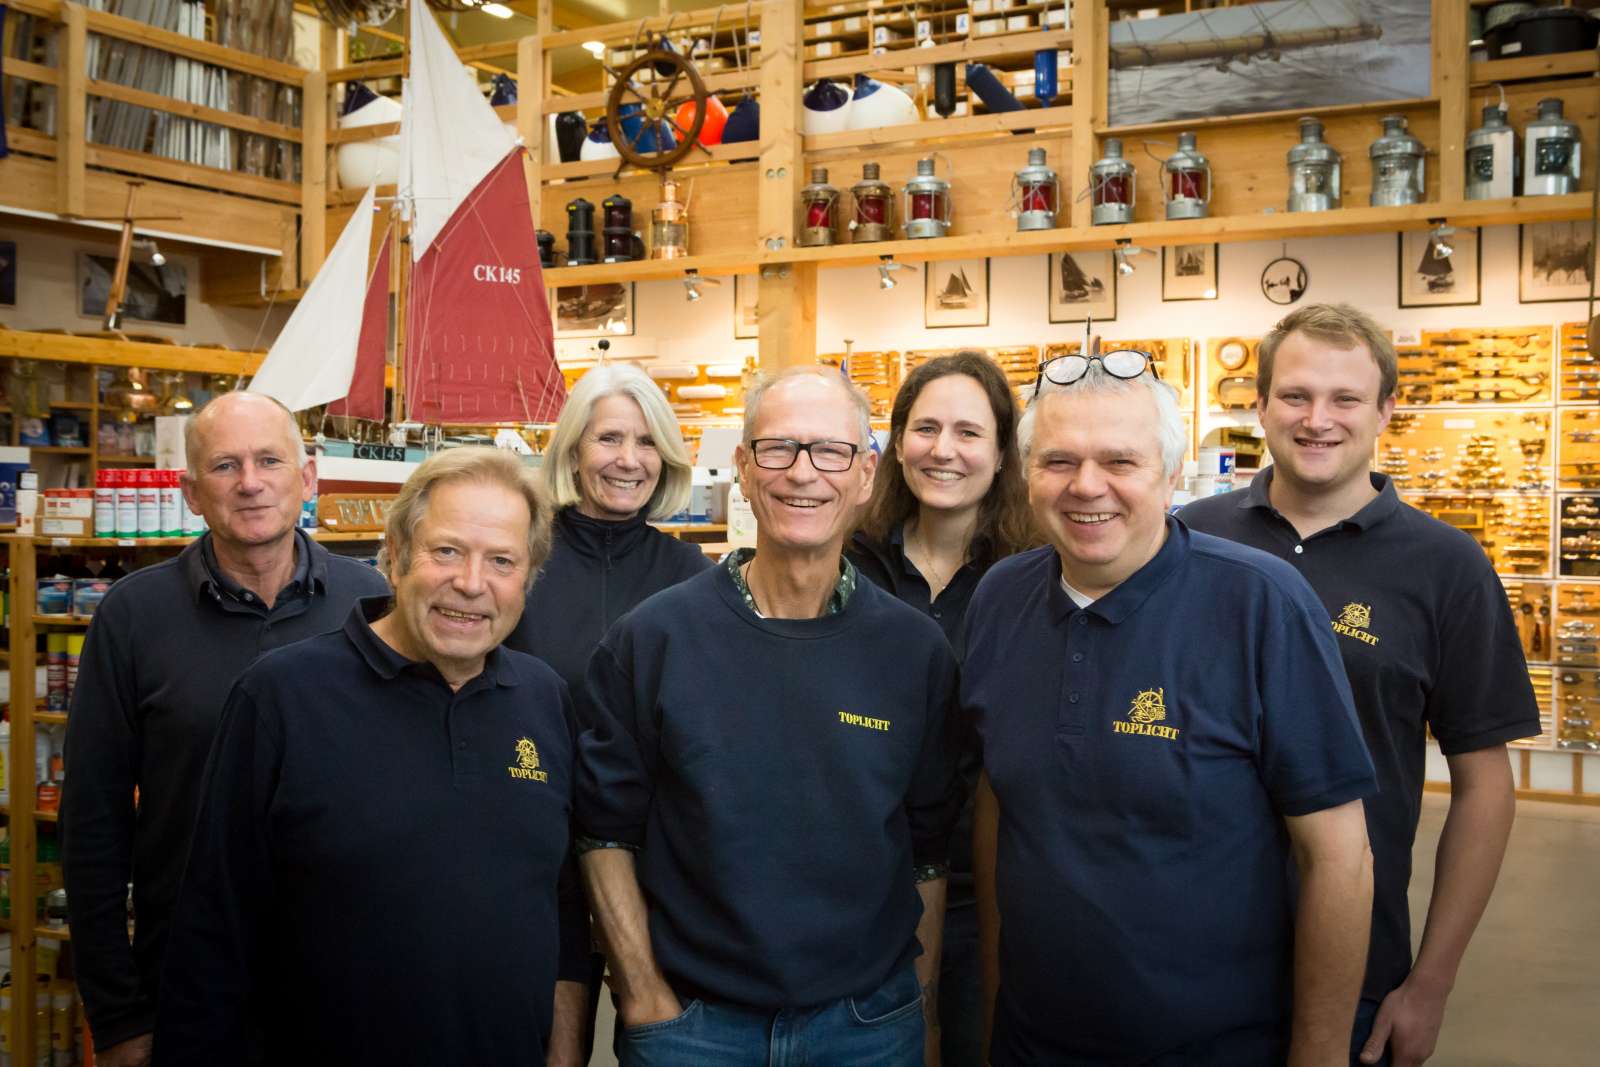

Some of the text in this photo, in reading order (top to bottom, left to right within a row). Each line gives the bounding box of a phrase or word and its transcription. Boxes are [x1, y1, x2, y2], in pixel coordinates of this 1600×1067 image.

[1331, 621, 1379, 646] OPLICHT
[838, 711, 891, 731] TOPLICHT
[1112, 720, 1180, 740] TOPLICHT
